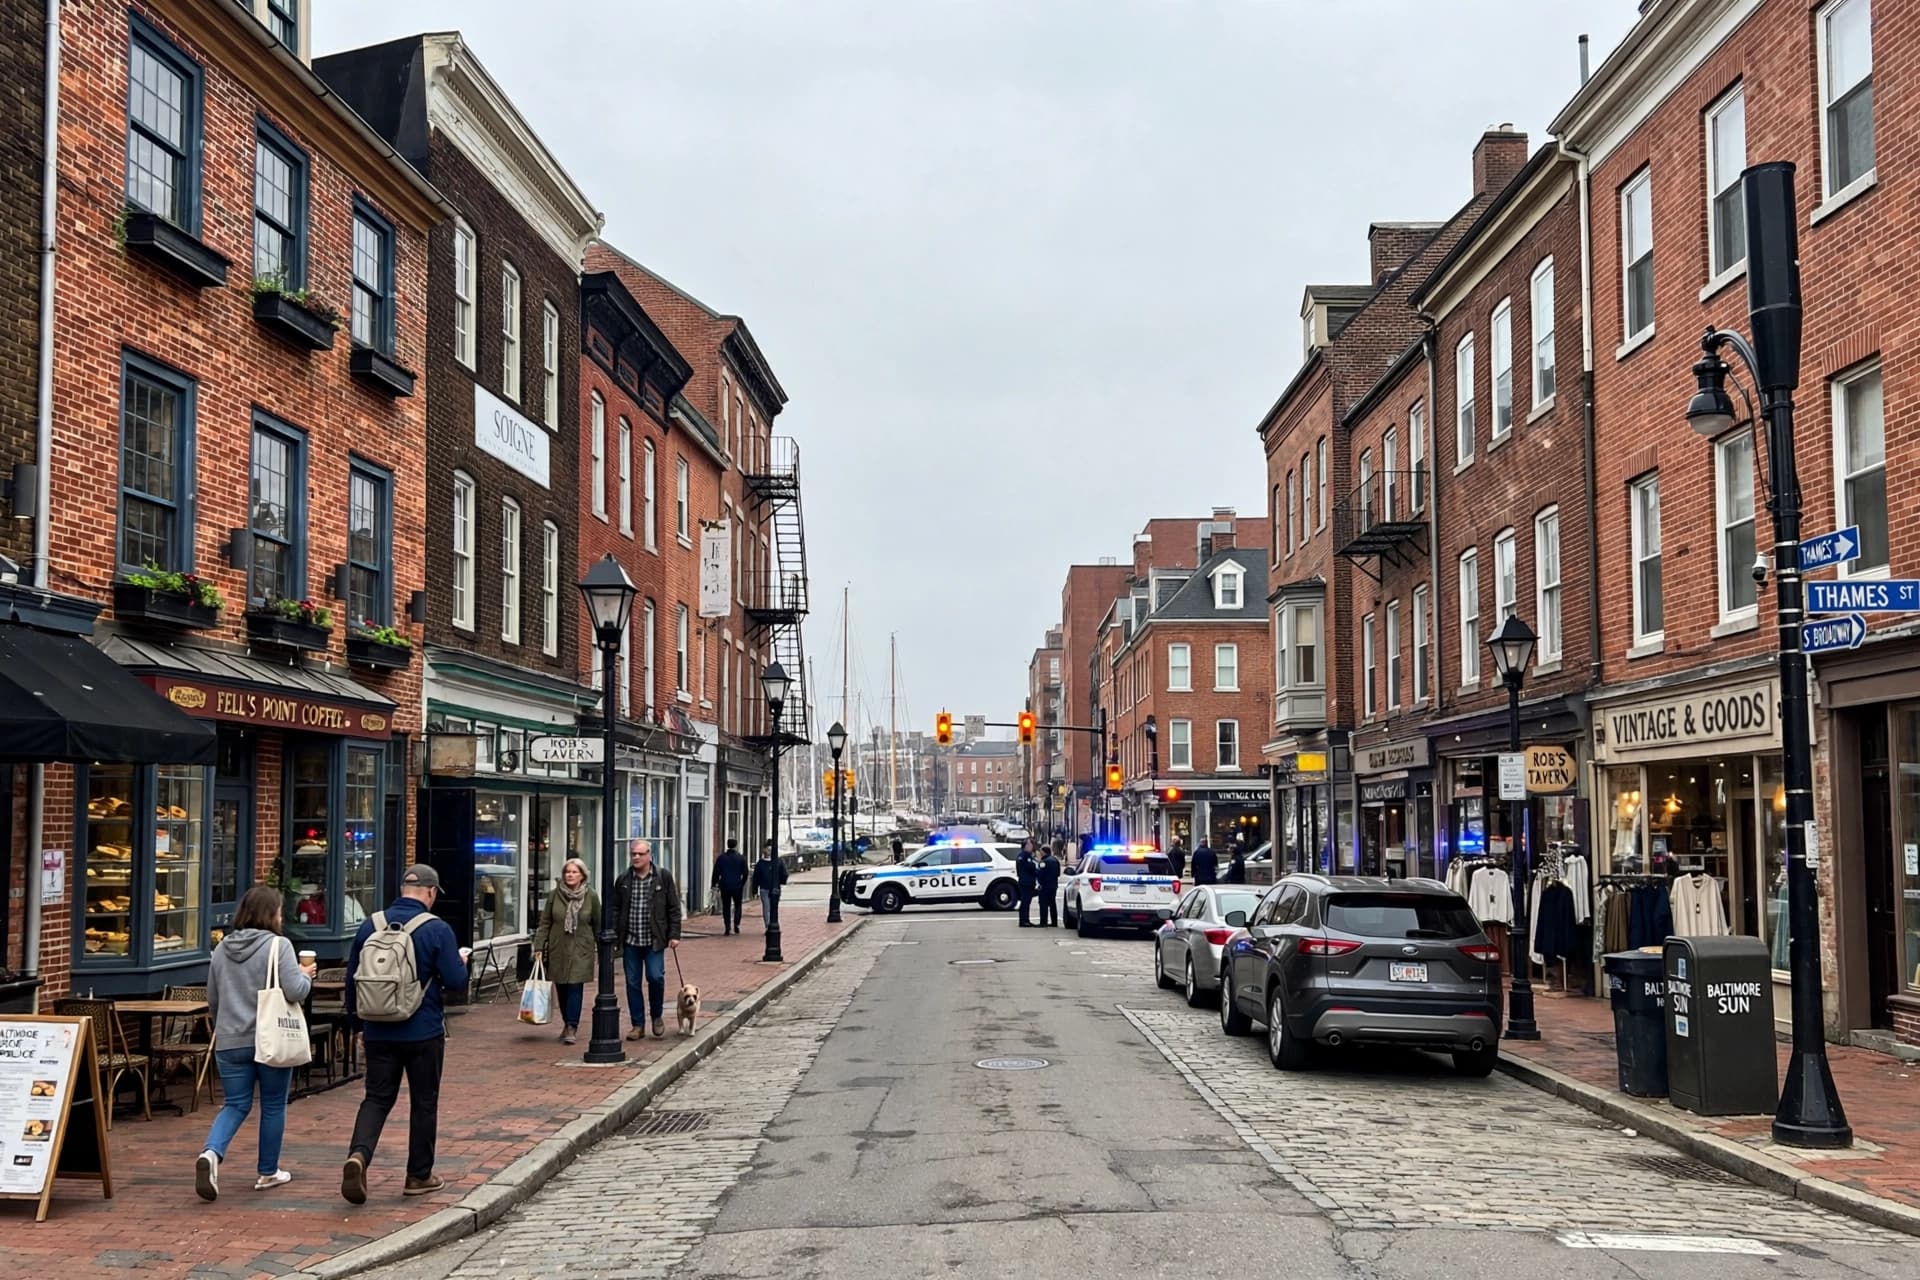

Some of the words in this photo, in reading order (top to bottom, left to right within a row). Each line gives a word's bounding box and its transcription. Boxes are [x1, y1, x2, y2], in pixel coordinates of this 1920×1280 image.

[1801, 539, 1832, 565] THAMES
[1815, 585, 1889, 608] THAMES
[1899, 585, 1914, 600] ST
[1803, 629, 1810, 648] S
[216, 691, 257, 717] FELL'S
[262, 698, 298, 723] POINT
[1613, 707, 1677, 744] VINTAGE
[1684, 704, 1696, 736] &
[1702, 691, 1765, 734] GOODS
[542, 749, 594, 760] TAVERN
[1533, 752, 1567, 767] ROB'S
[1528, 768, 1569, 785] TAVERN
[919, 876, 977, 888] POLICE
[1644, 982, 1665, 996] BALT
[1707, 982, 1761, 998] BALTIMORE
[1718, 997, 1750, 1014] SUN
